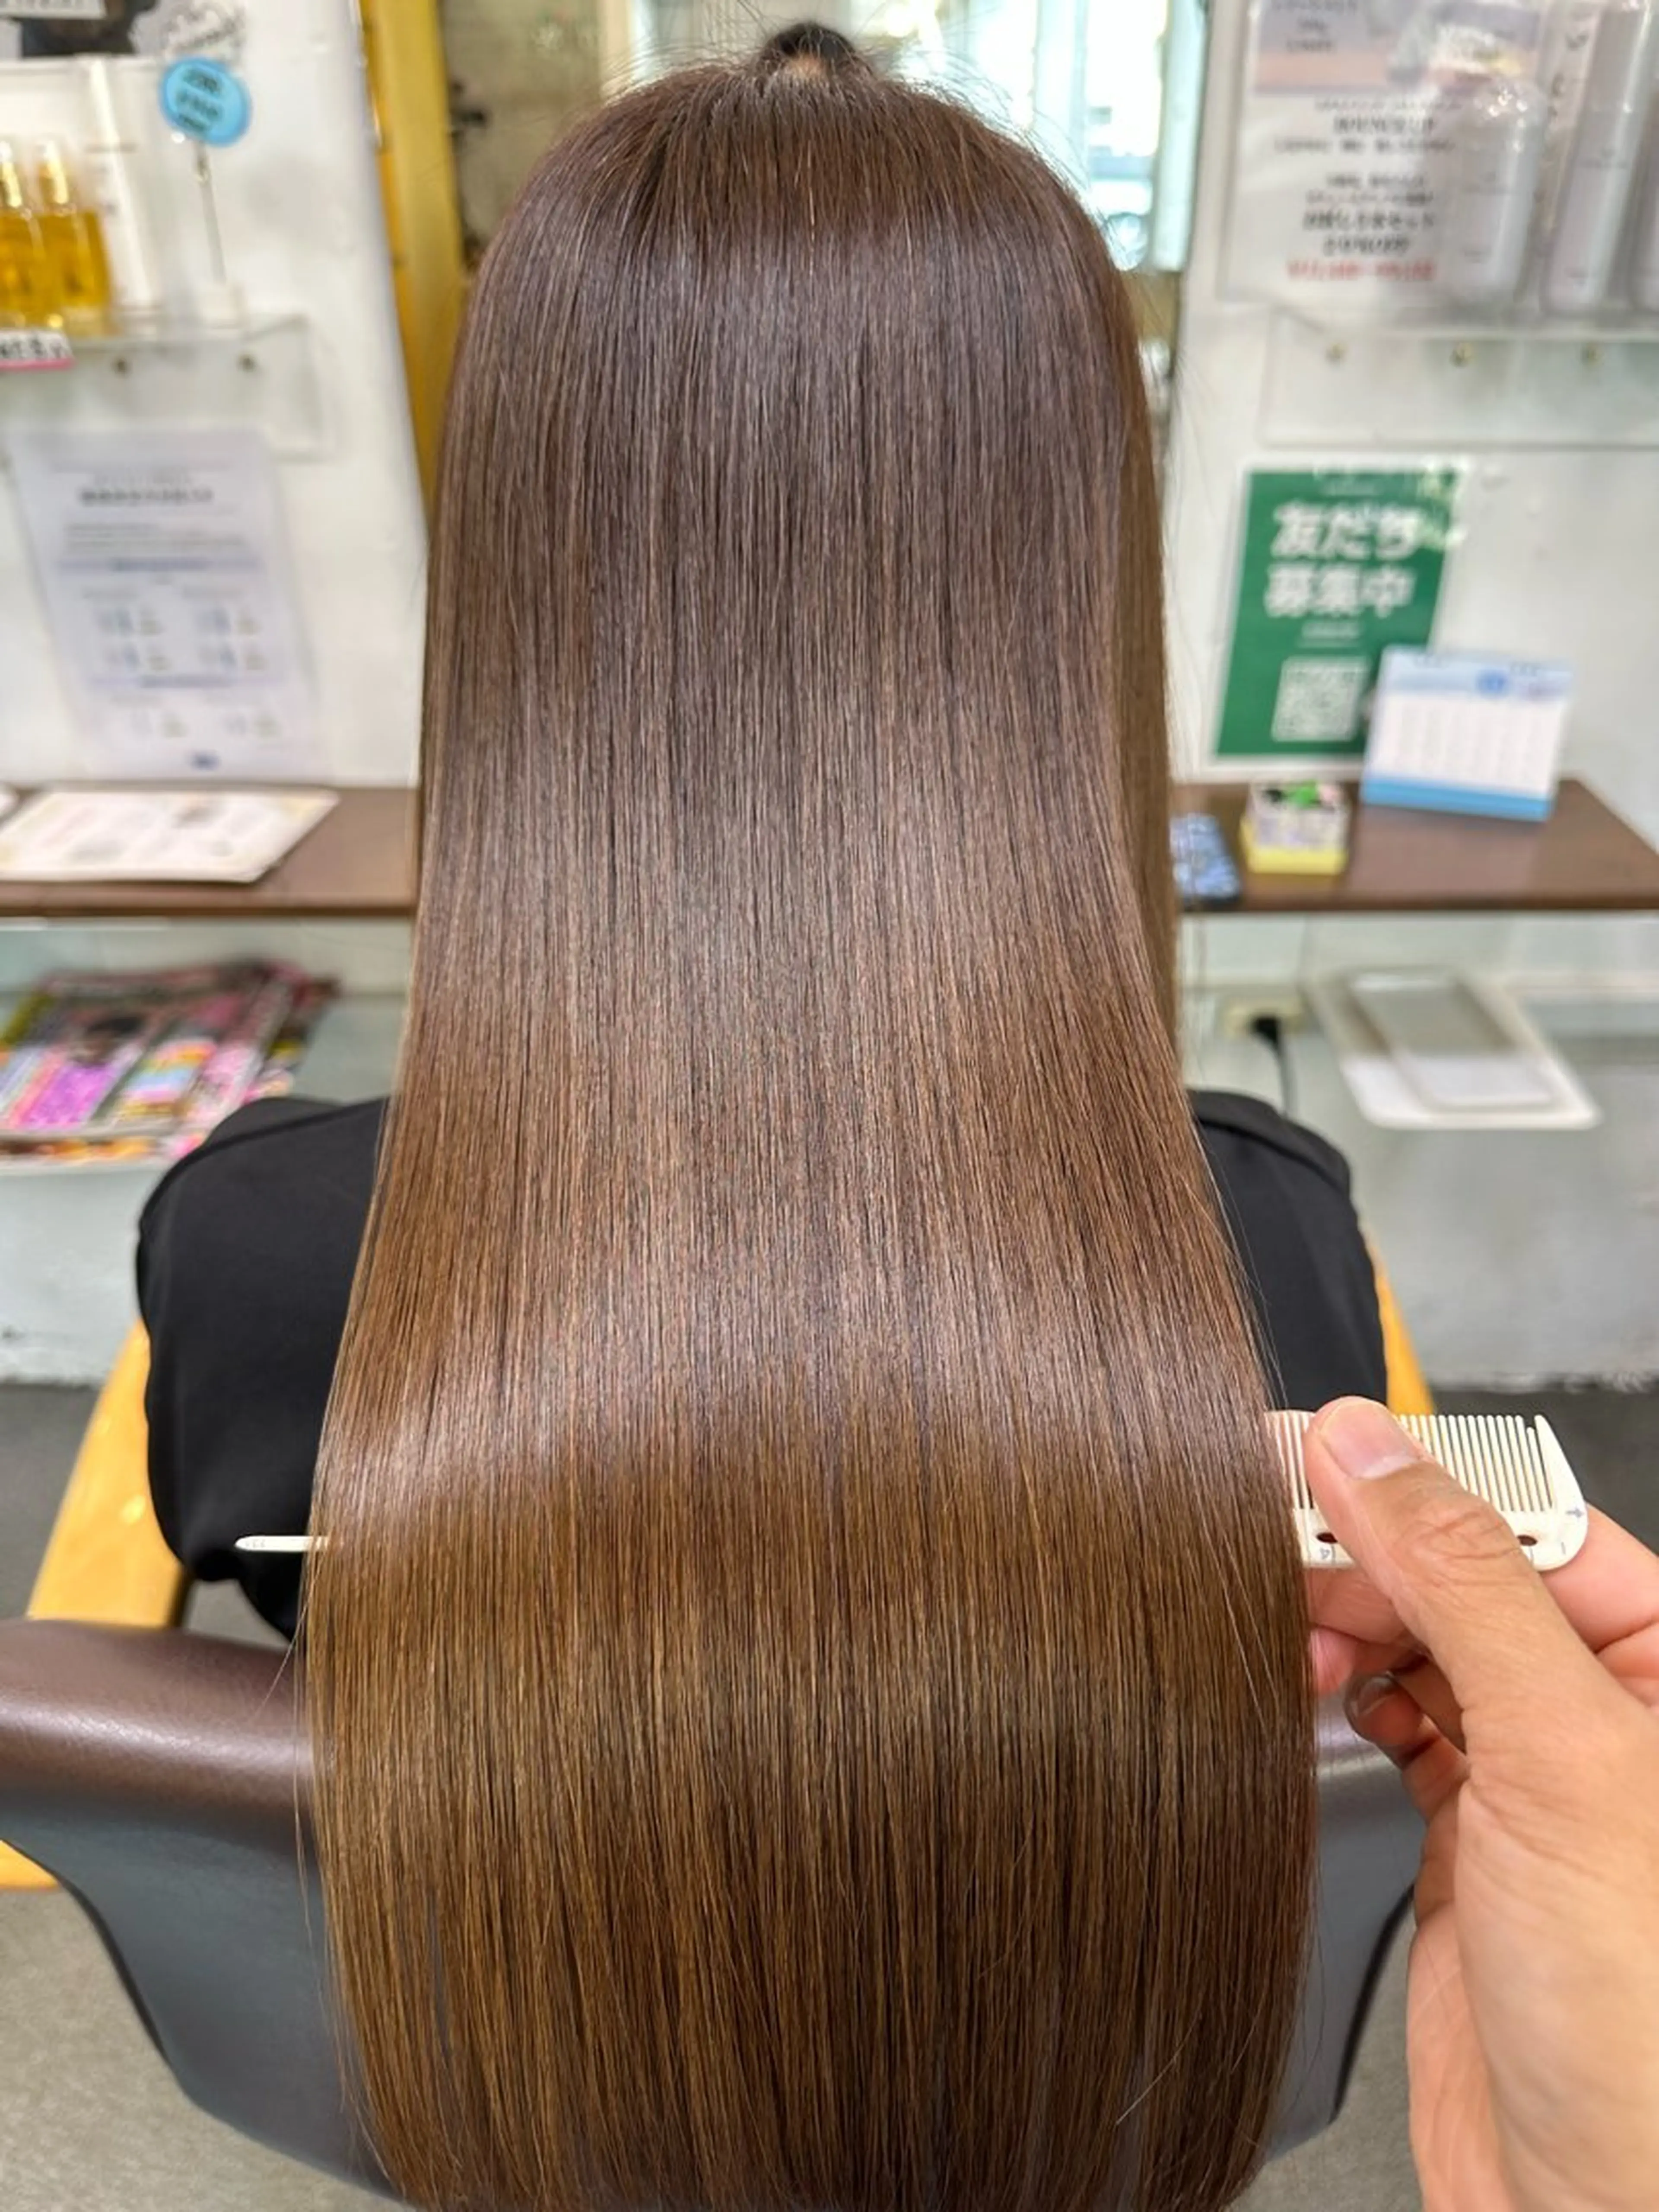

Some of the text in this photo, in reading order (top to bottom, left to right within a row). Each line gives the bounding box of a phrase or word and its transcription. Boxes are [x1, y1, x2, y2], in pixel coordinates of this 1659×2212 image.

[1272, 502, 1418, 559] 友だち
[1265, 564, 1414, 617] 募集中
